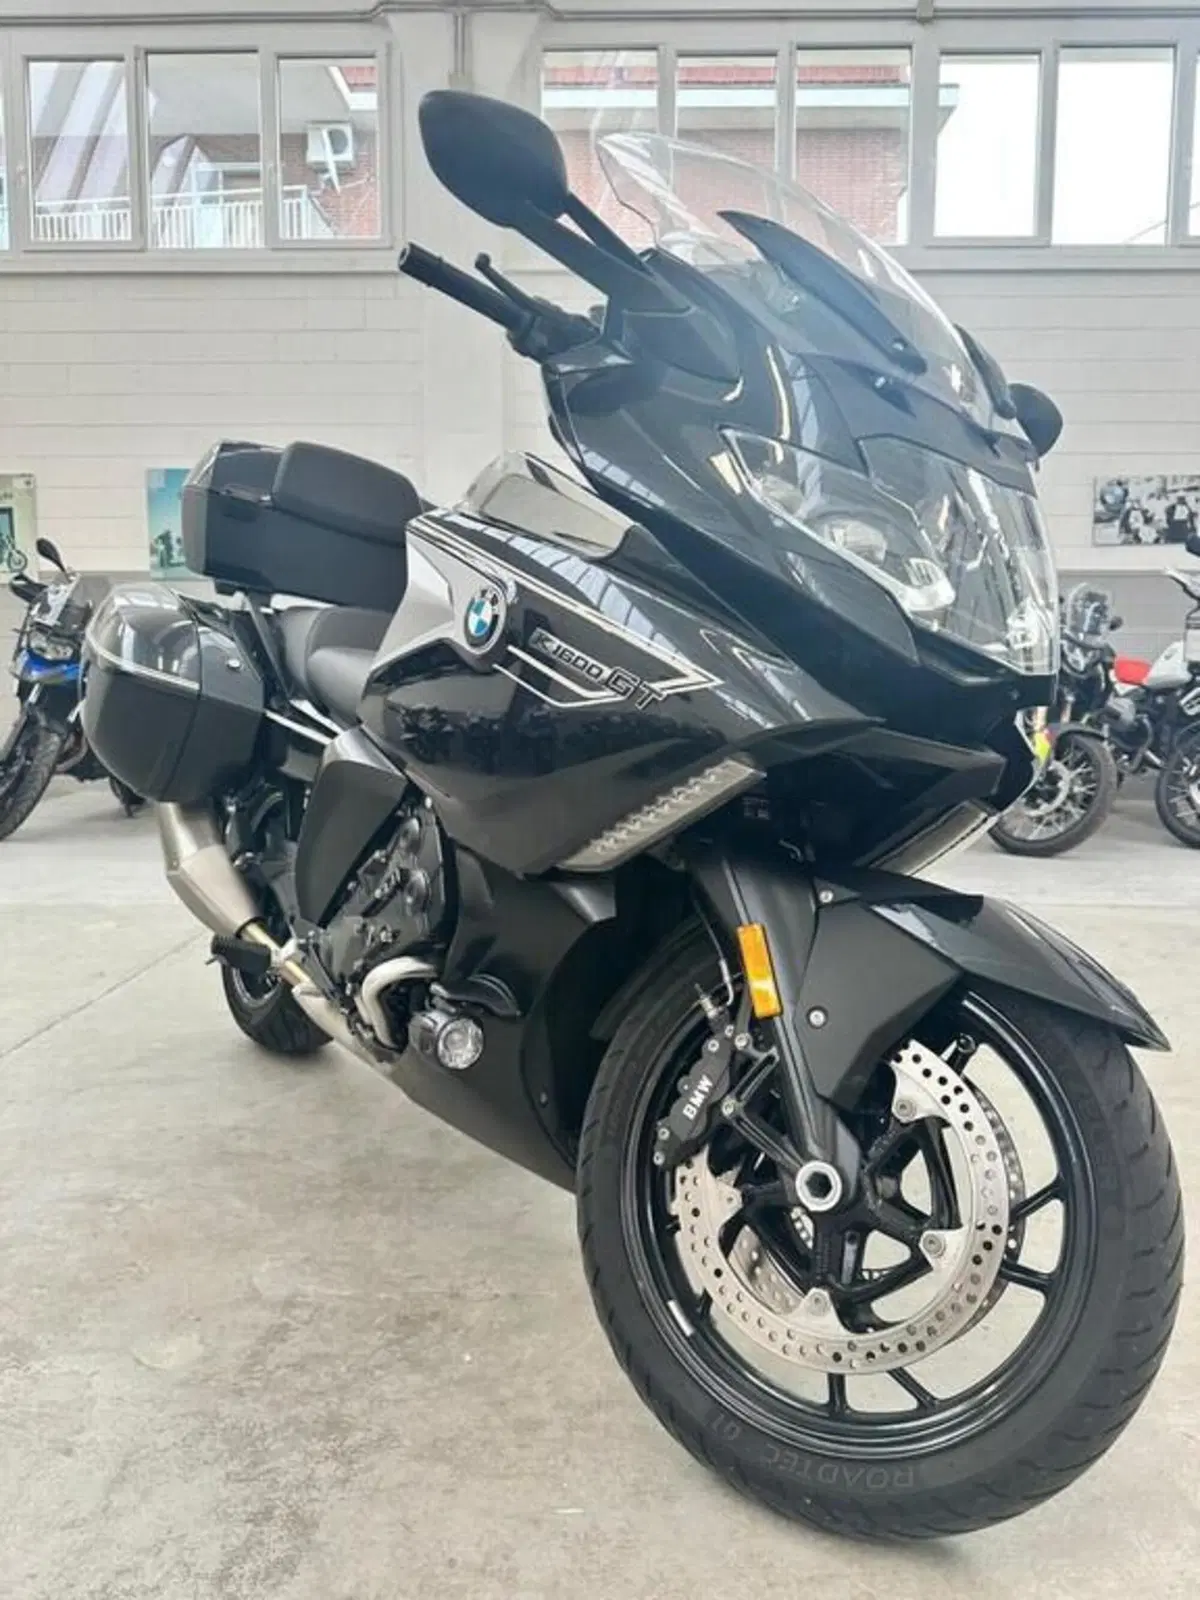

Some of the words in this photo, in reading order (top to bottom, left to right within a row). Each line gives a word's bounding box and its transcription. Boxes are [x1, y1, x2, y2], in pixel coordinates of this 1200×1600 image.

[605, 666, 667, 711] GT
[682, 1074, 713, 1120] BMW
[763, 1443, 913, 1489] ROADTEC
